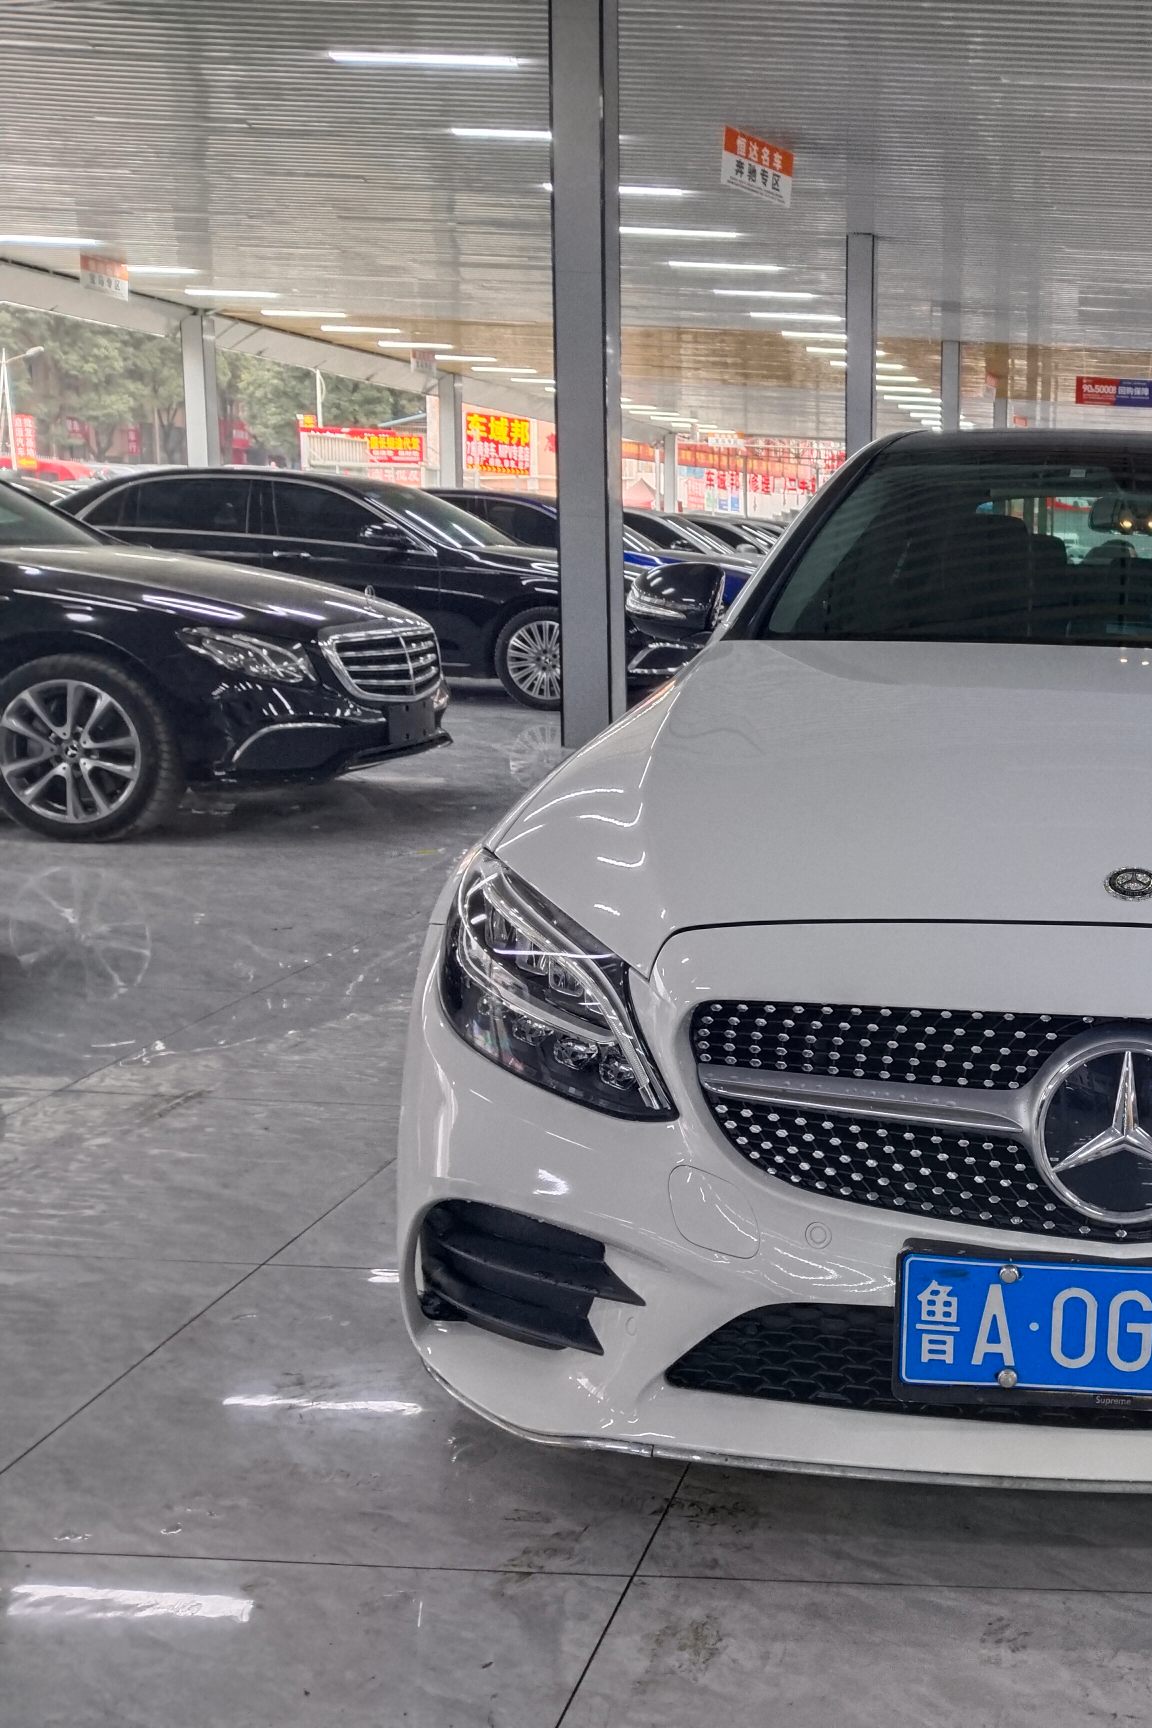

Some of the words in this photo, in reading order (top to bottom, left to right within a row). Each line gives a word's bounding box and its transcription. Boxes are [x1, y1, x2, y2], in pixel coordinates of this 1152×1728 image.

[735, 158, 781, 192] 奔驰专区
[466, 413, 529, 447] 车城邦
[1095, 1395, 1132, 1406] Supreme
